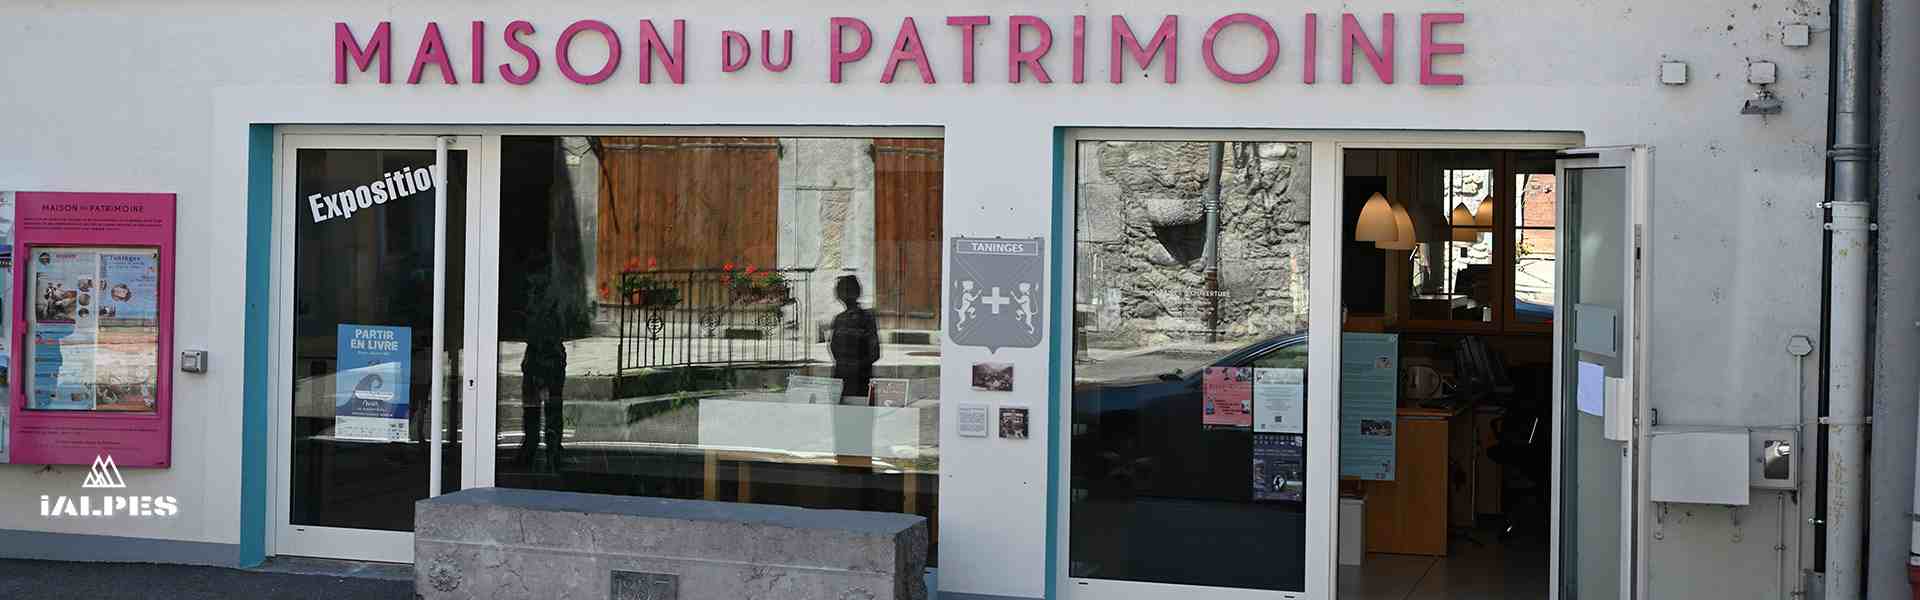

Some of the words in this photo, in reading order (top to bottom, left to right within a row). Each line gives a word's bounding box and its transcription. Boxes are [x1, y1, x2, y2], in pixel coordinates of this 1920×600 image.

[334, 18, 687, 86] MAISON
[721, 29, 794, 73] DU
[829, 12, 1465, 87] PATRIMOINE
[41, 204, 78, 212] MAISON
[89, 204, 145, 213] PATRIMOINE
[970, 242, 1025, 253] TANINGES
[355, 328, 395, 341] PARTIR
[350, 338, 366, 350] EN
[367, 340, 399, 352] LIVRE
